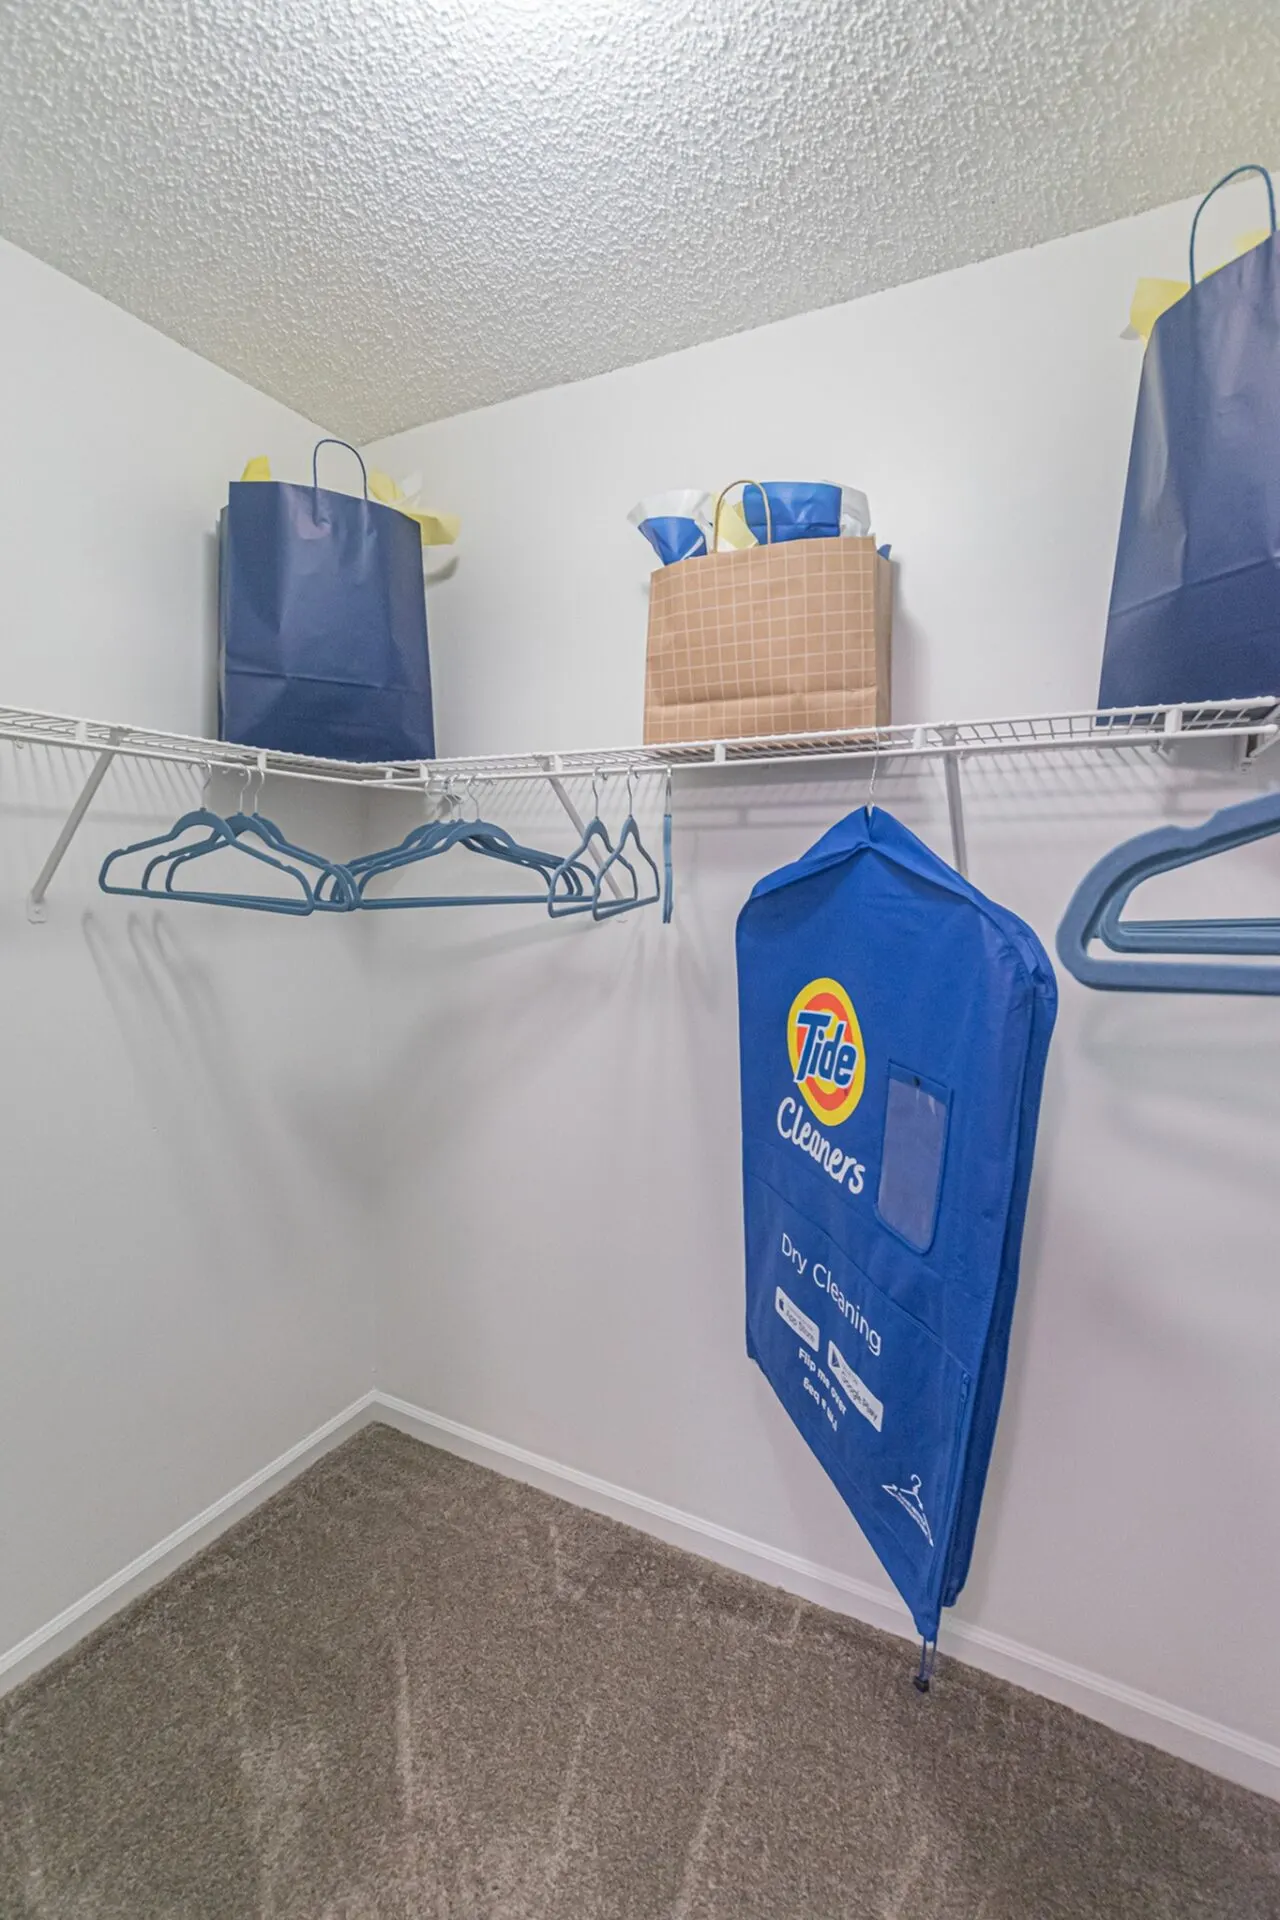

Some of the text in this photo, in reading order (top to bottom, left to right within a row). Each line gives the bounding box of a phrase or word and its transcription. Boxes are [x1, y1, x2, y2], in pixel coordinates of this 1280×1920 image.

[794, 1010, 857, 1088] Tide
[777, 1096, 866, 1195] Cleaners
[782, 1232, 807, 1275] Dry
[813, 1263, 881, 1356] Cleaning
